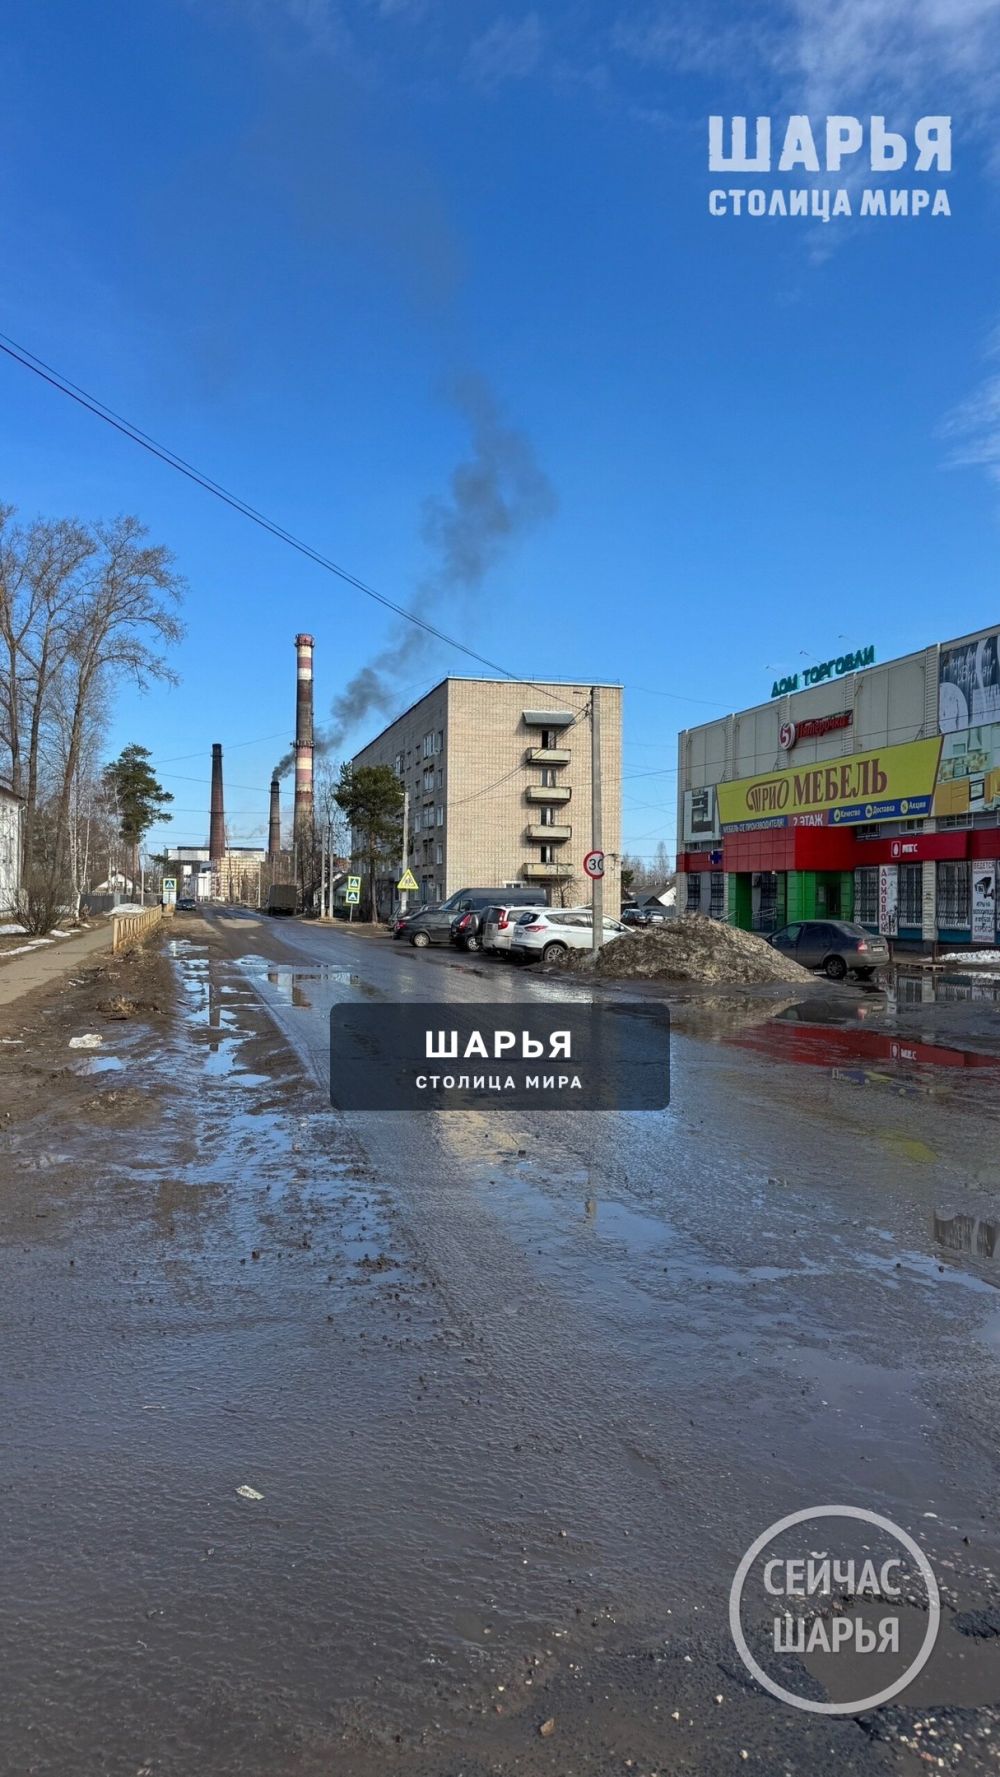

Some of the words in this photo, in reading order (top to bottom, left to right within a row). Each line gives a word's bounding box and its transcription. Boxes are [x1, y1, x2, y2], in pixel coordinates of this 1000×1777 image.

[771, 674, 798, 698] ДОМ
[802, 645, 875, 686] ТОРГОВЛИ
[793, 758, 888, 806] МЕБЕЛЬ
[873, 804, 896, 815] Доставка
[800, 813, 823, 826] ЭТАЖ
[589, 858, 604, 871] 30
